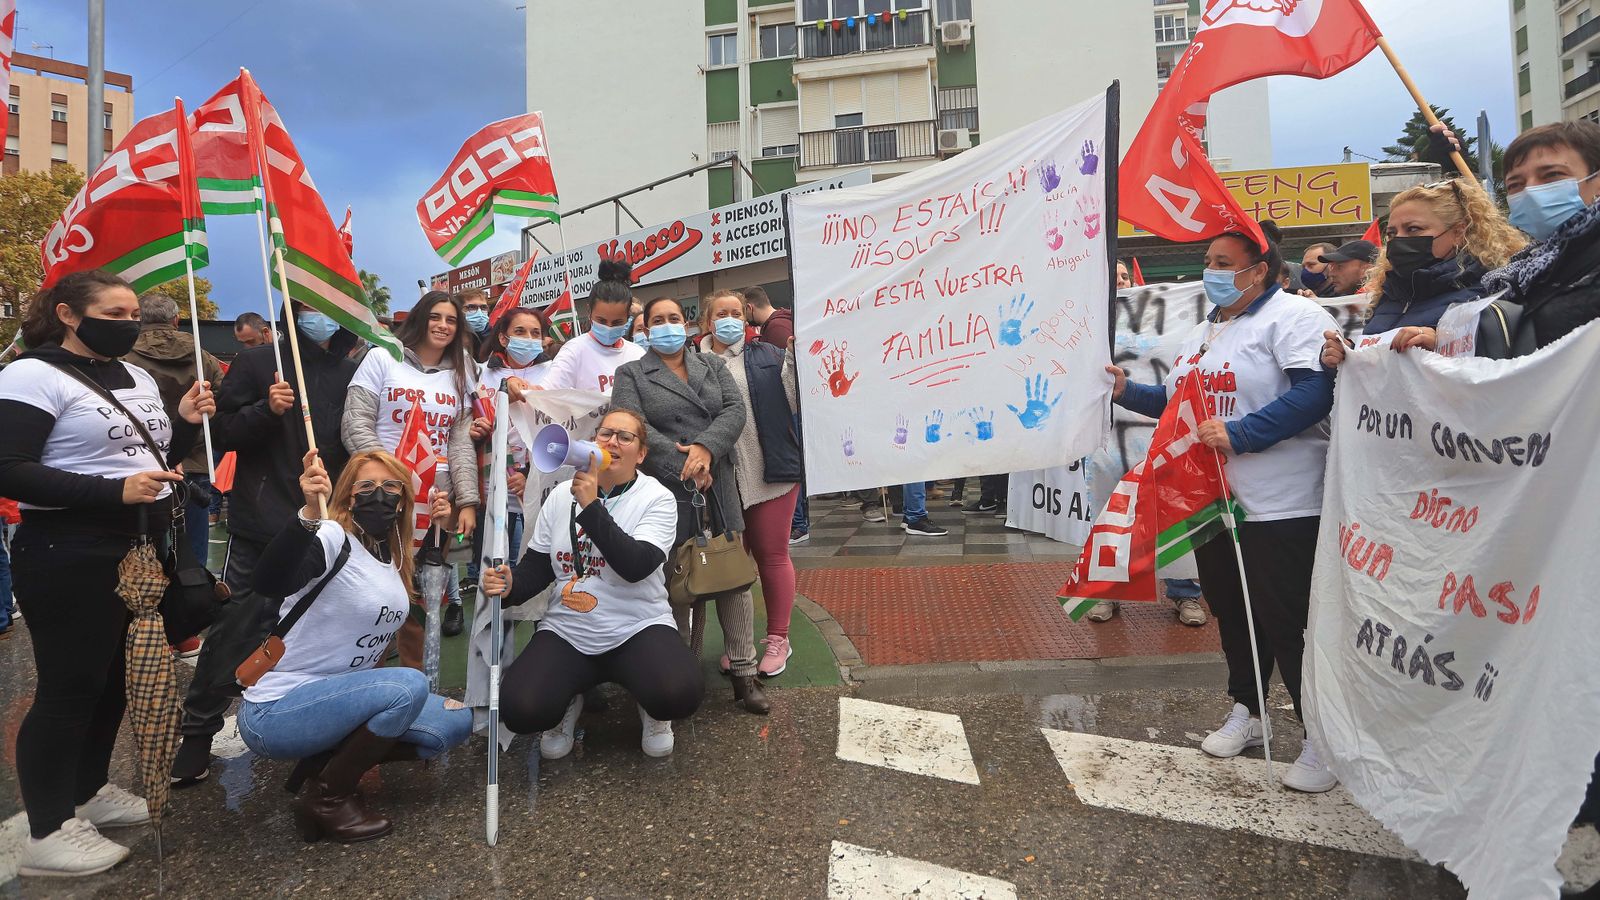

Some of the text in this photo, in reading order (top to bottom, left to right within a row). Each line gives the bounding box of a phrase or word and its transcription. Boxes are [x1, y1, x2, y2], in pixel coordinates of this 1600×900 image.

[1046, 184, 1078, 202] LUCÍA
[724, 199, 779, 224] PIENSOS,
[597, 219, 685, 266] Velasco
[725, 218, 785, 243] ACCESORI
[726, 237, 788, 263] INSECTICI
[1047, 249, 1091, 272] Abigail
[459, 266, 480, 280] MESÓN
[524, 275, 546, 291] RUTAS
[823, 262, 1024, 318] AQUÍ ESTÁ VUESTRA
[436, 392, 456, 407] UN
[1357, 403, 1382, 437] POR
[374, 605, 404, 626] POR
[1356, 618, 1465, 691] ATRÁS
